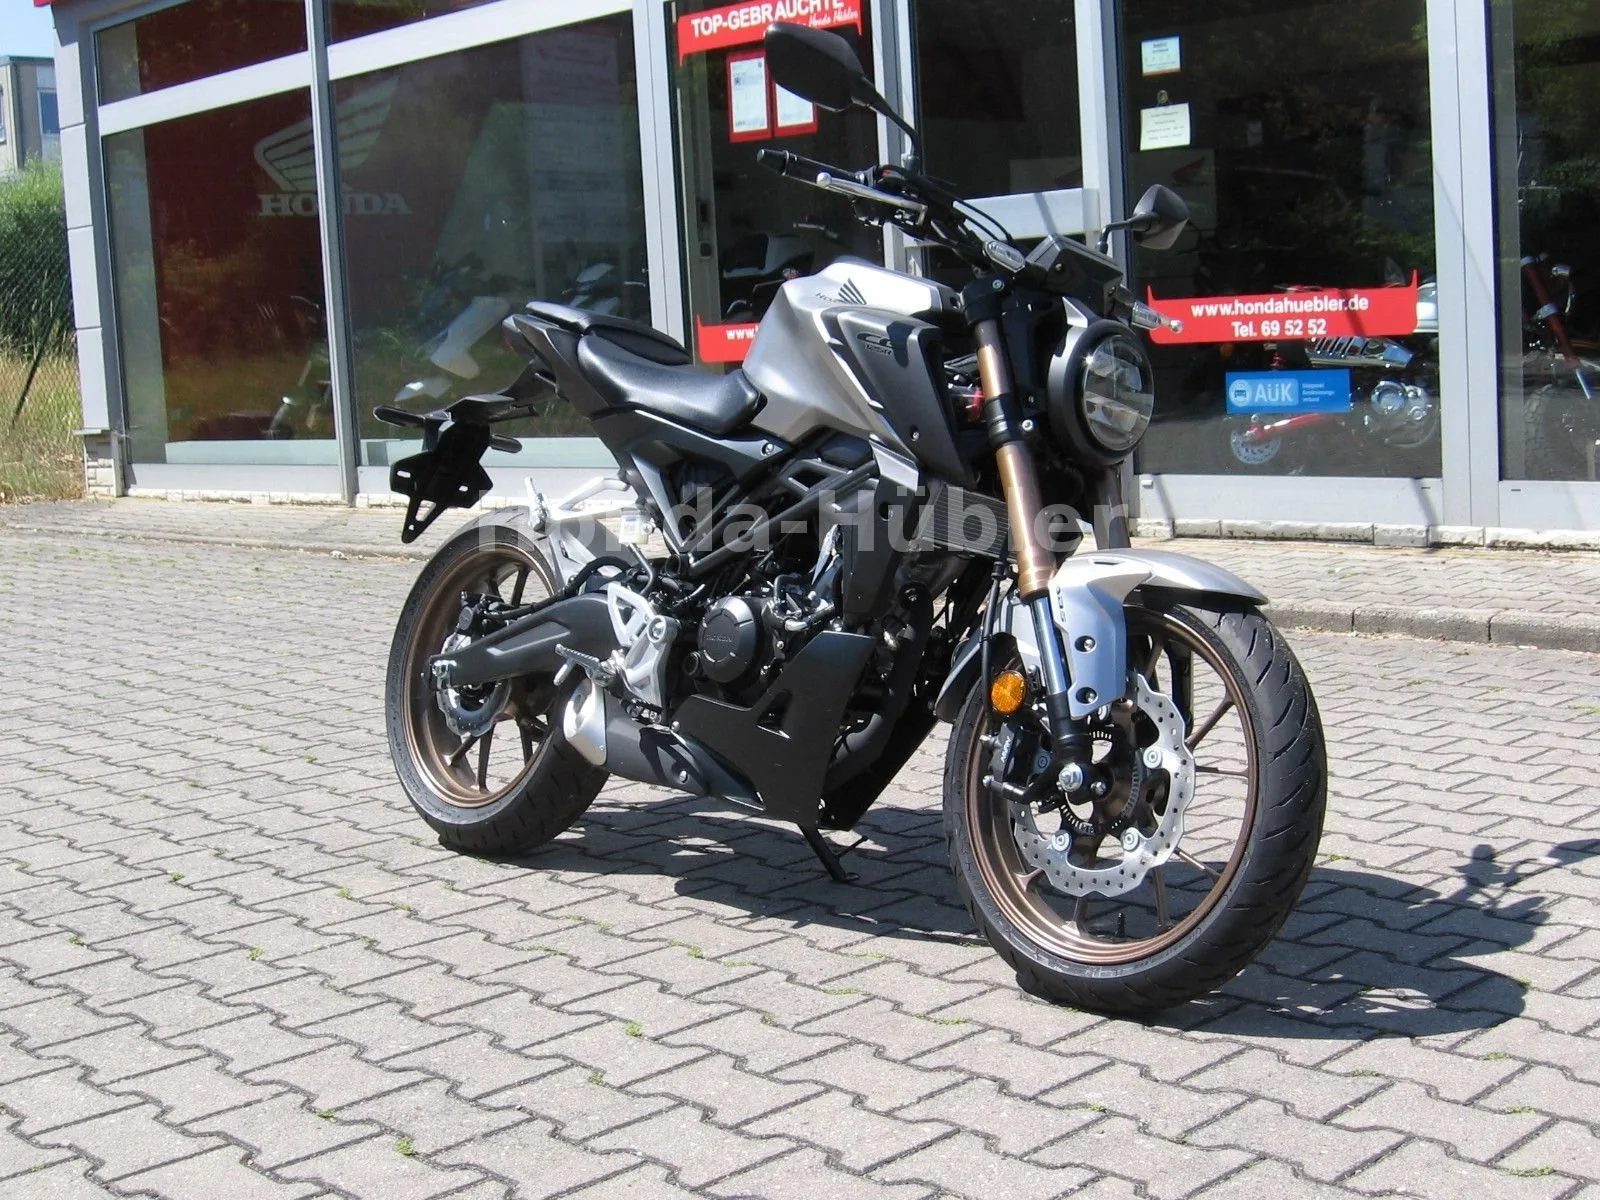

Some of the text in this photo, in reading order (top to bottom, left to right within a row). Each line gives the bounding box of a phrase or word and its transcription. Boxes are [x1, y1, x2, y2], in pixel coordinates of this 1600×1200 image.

[257, 192, 412, 216] HODA
[1190, 294, 1370, 317] www.hondahuebler.de
[1231, 318, 1327, 338] Tel. 69 52 52
